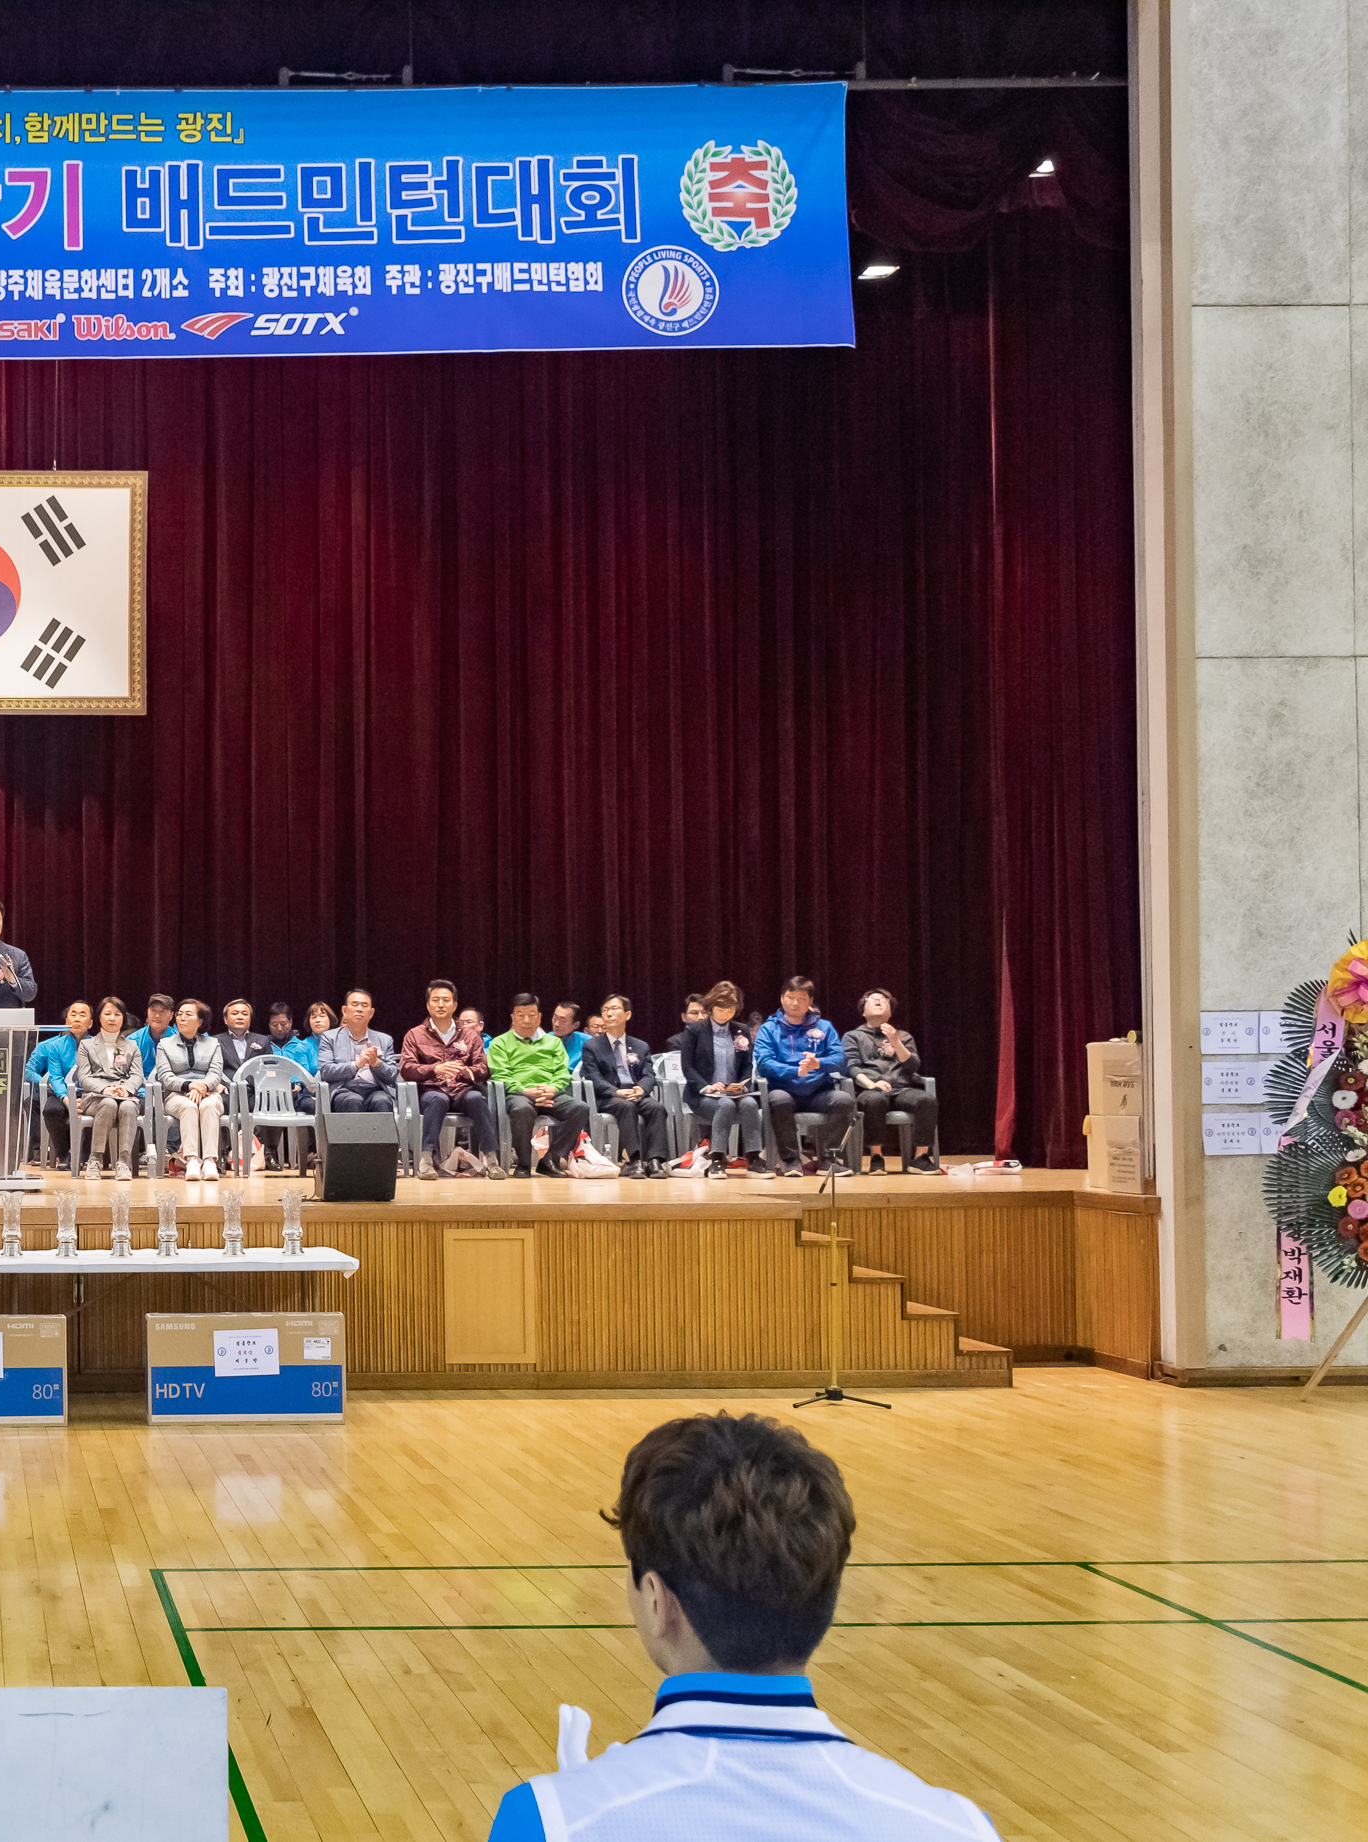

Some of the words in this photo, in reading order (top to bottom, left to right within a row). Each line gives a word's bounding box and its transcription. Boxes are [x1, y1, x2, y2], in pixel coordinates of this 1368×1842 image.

[122, 154, 642, 251] 배드민턴대회
[707, 156, 772, 231] 축
[141, 268, 189, 299] 2개소
[261, 265, 372, 299] 광진구체육회
[438, 262, 604, 295] 광진구배드민턴협회
[628, 255, 654, 283] PEOPLE
[653, 250, 682, 260] LIVING
[683, 254, 710, 281] SPORTS
[154, 1322, 196, 1331] SAMSUNG
